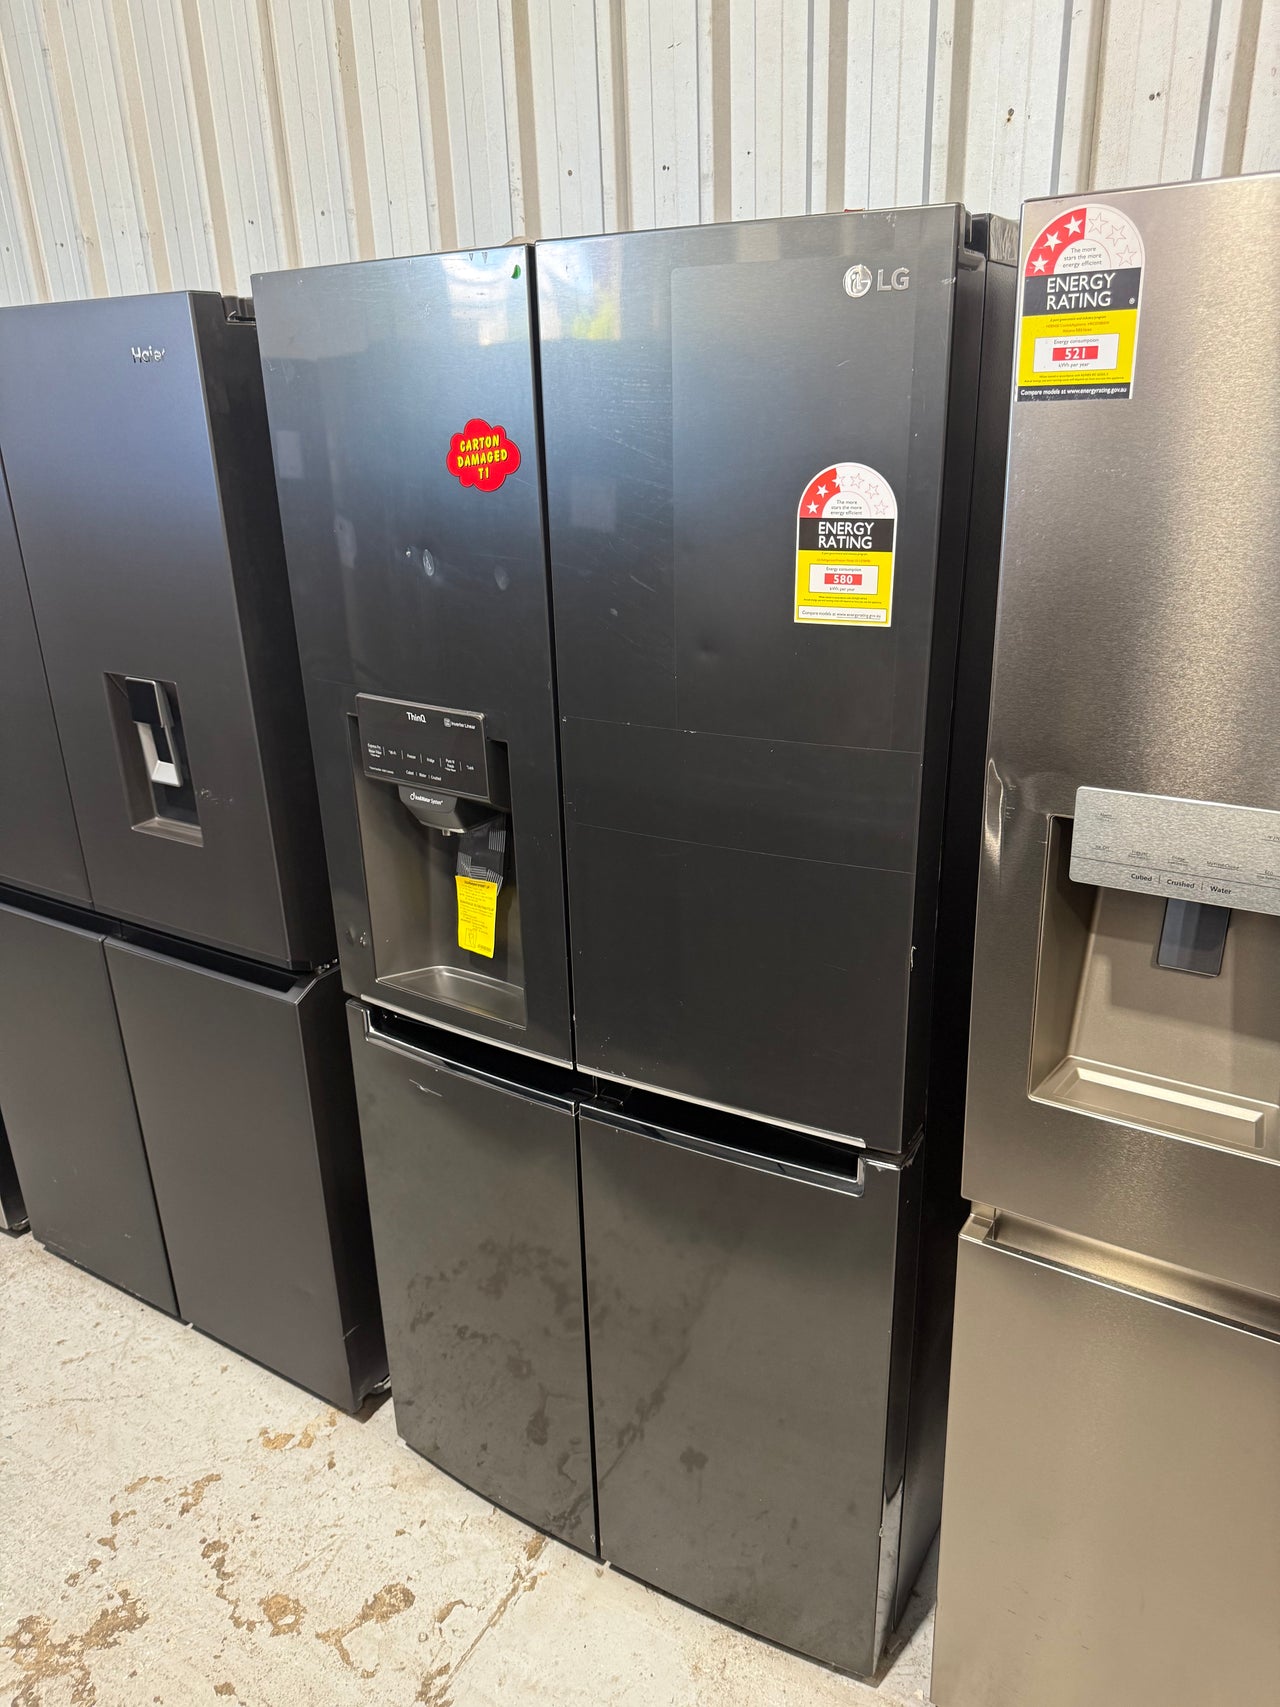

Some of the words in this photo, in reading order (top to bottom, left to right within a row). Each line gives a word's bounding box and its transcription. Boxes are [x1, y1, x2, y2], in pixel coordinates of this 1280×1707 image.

[1062, 261, 1080, 269] energy
[877, 267, 909, 291] LG
[1046, 272, 1116, 293] ENERGY
[1046, 291, 1112, 311] RATING
[1064, 348, 1086, 359] 521
[460, 435, 499, 452] CARTON
[457, 449, 507, 468] DAMAGED
[478, 467, 489, 480] T1
[818, 521, 874, 535] ENERGY
[818, 535, 873, 549] RATING
[833, 575, 853, 584] 580
[406, 711, 426, 723] ThinQ
[1131, 873, 1153, 882] Cubed
[1166, 878, 1196, 889] Crushed
[1210, 885, 1232, 895] Water
